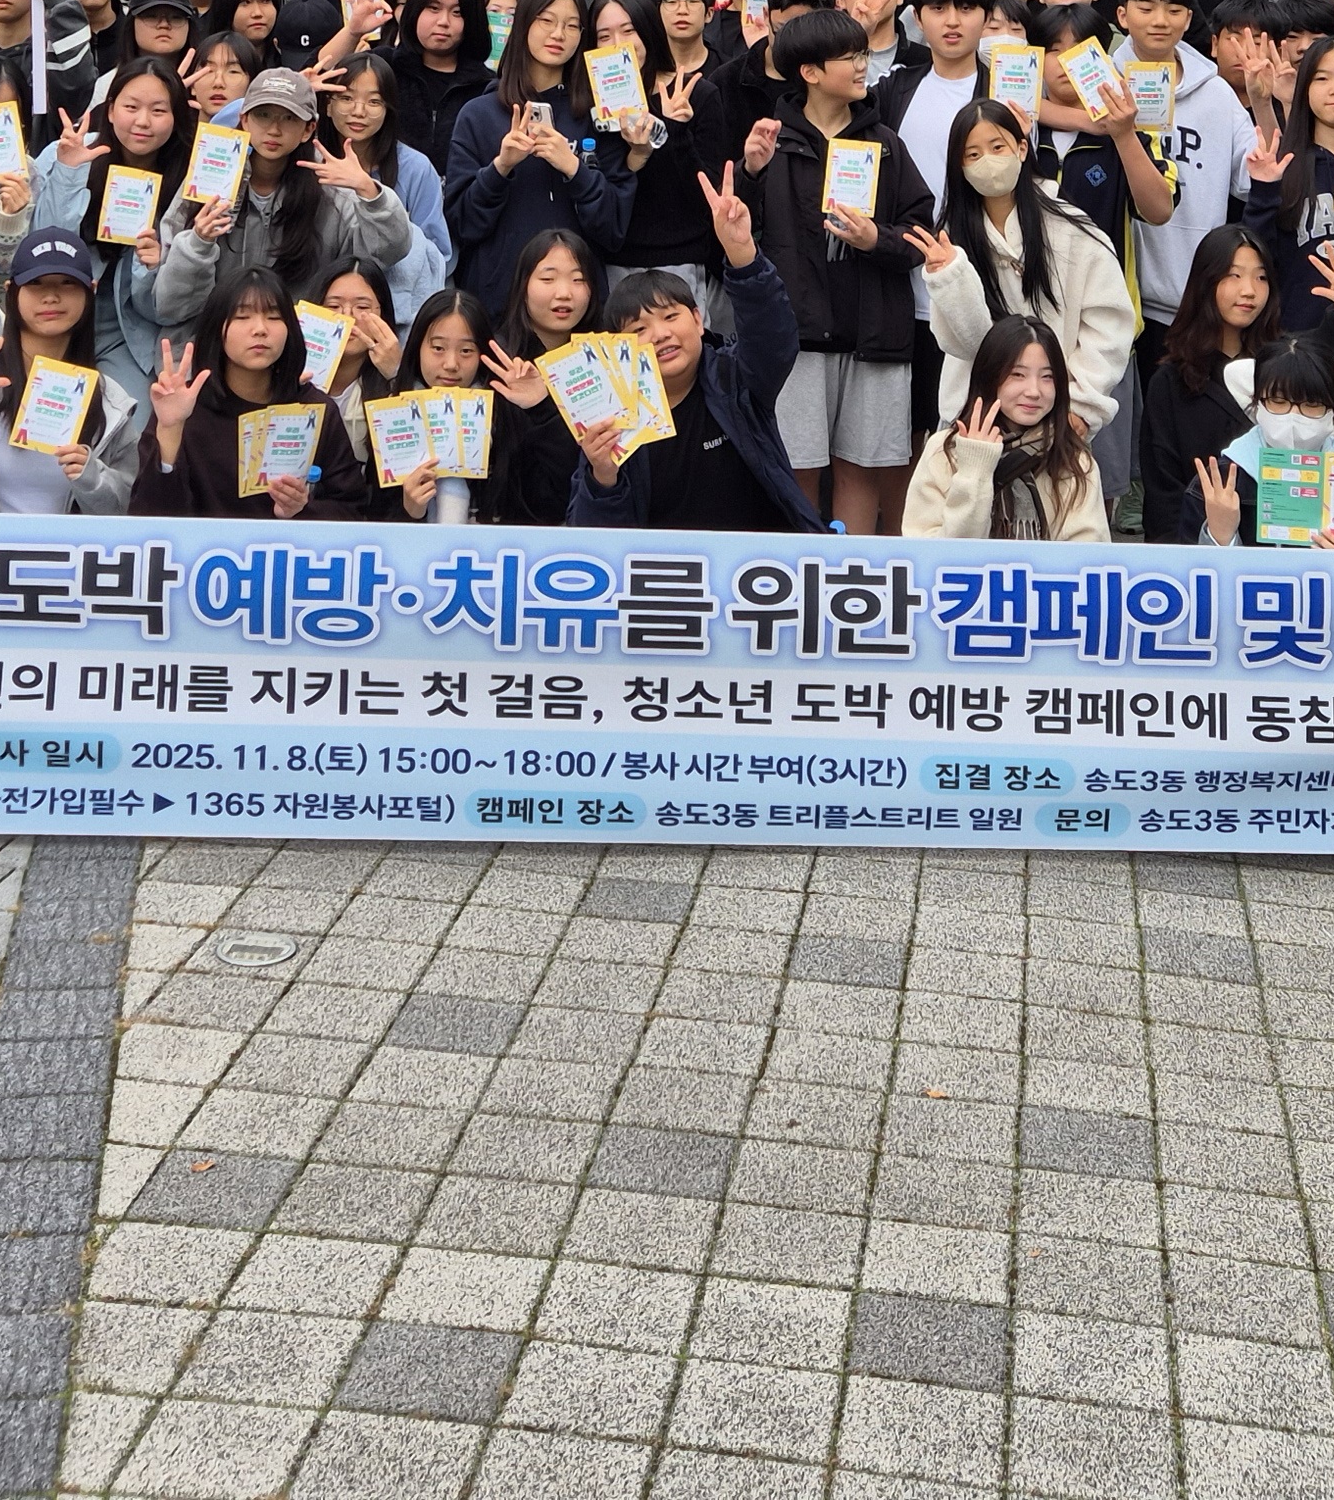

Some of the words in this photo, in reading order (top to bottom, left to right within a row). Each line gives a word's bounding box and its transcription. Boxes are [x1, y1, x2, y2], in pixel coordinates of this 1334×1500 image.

[194, 549, 714, 654] 예방·치유를
[731, 563, 922, 661] 위한
[937, 569, 1217, 661] 캠페인
[1242, 577, 1332, 665] 및
[78, 662, 234, 713] 미래를
[250, 667, 405, 716] 지키는
[421, 671, 469, 718] 첫
[488, 673, 603, 724] 걸음,
[622, 676, 773, 725] 청소년
[791, 682, 893, 729] 도박
[908, 684, 1010, 732] 예방
[1025, 687, 1228, 741] 캠페인에
[42, 740, 104, 769] 일시
[684, 752, 743, 783] 시간
[747, 754, 907, 790] 부여(3시간)
[935, 762, 991, 791] 집결
[1003, 765, 1061, 792] 장소
[1083, 768, 1187, 793] 송도3동
[186, 791, 265, 817] 1365
[272, 792, 455, 824] 자원봉사포털)
[476, 796, 564, 824] 캠페인
[576, 798, 635, 825] 장소
[655, 801, 760, 828] 송도3동
[766, 804, 961, 831] 트리플스트리트
[968, 807, 1023, 831] 일원
[1054, 808, 1111, 832] 문의
[1138, 808, 1241, 833] 송도3동
